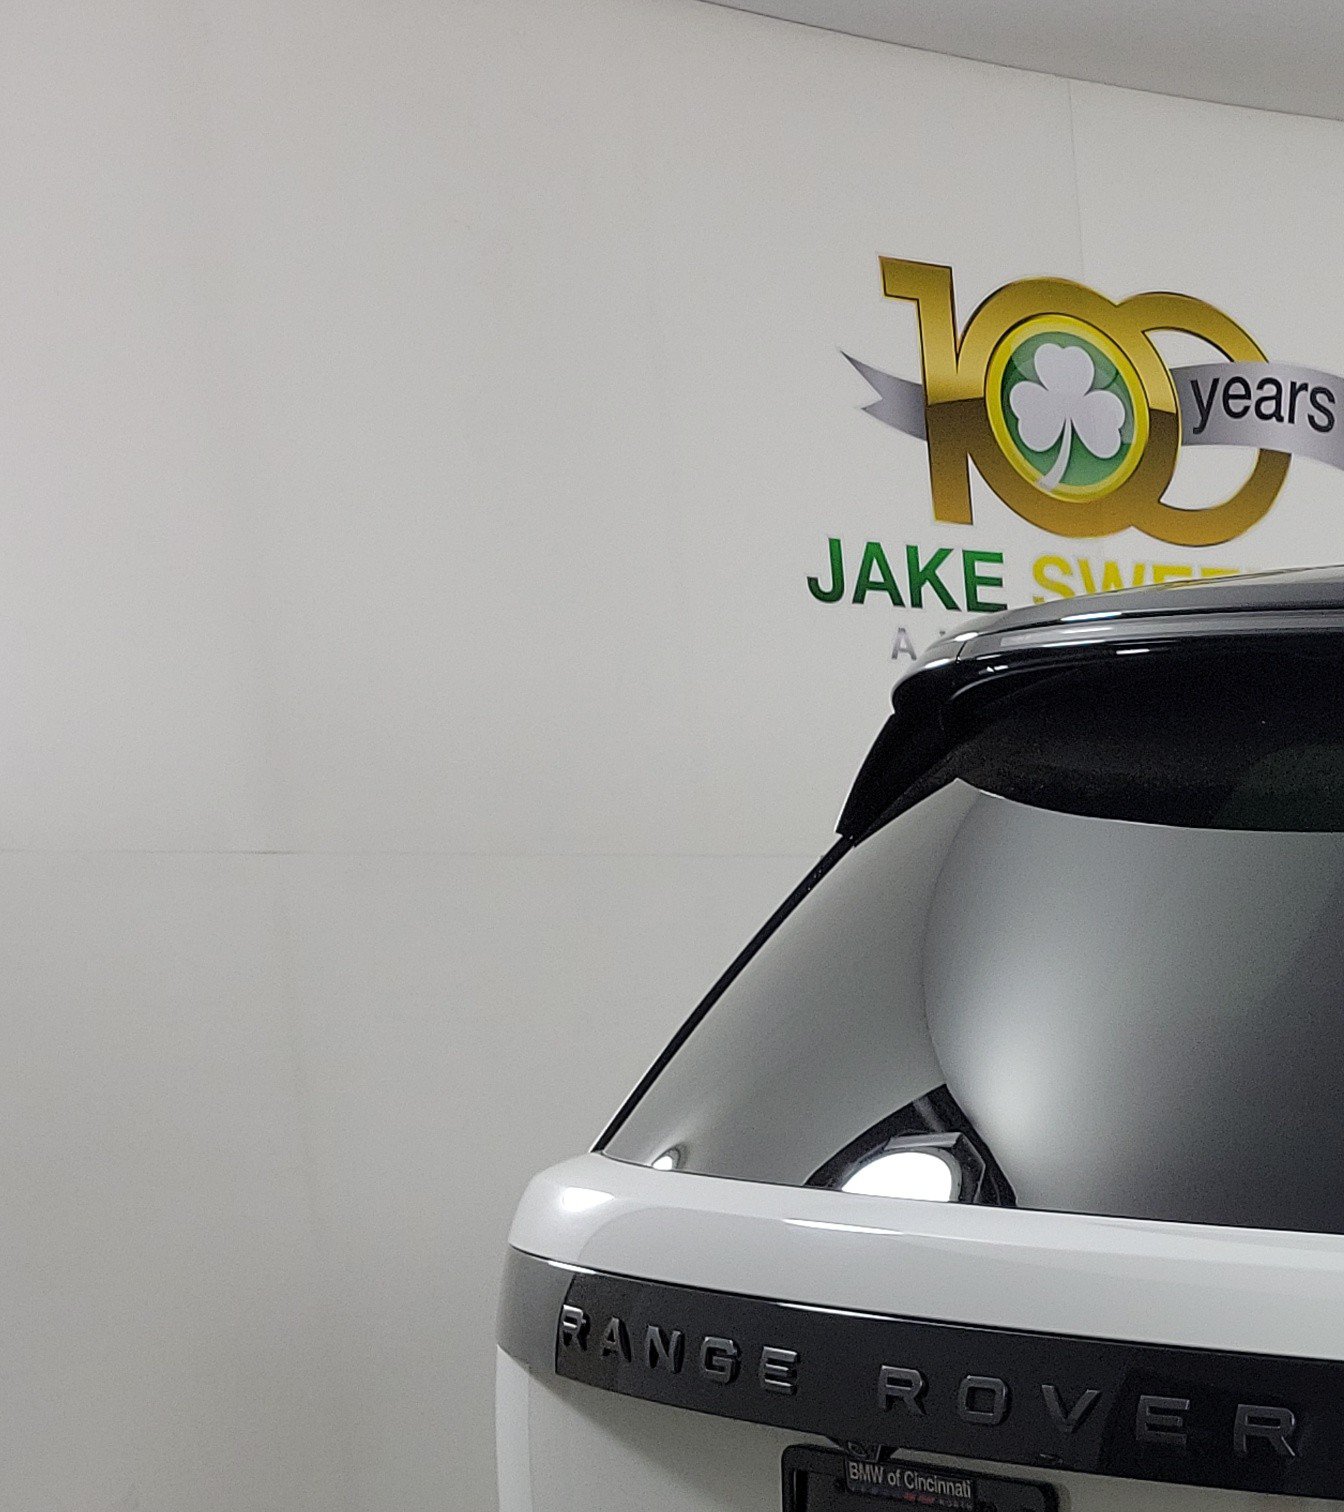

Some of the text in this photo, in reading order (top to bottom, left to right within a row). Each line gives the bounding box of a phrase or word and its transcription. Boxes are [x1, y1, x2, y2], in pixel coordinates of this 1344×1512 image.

[877, 255, 1293, 548] 100
[1190, 376, 1337, 435] years
[806, 537, 1008, 615] JAKE
[560, 1303, 1299, 1458] RANGE ROVER
[849, 1462, 971, 1499] BMW of Cincinnati
